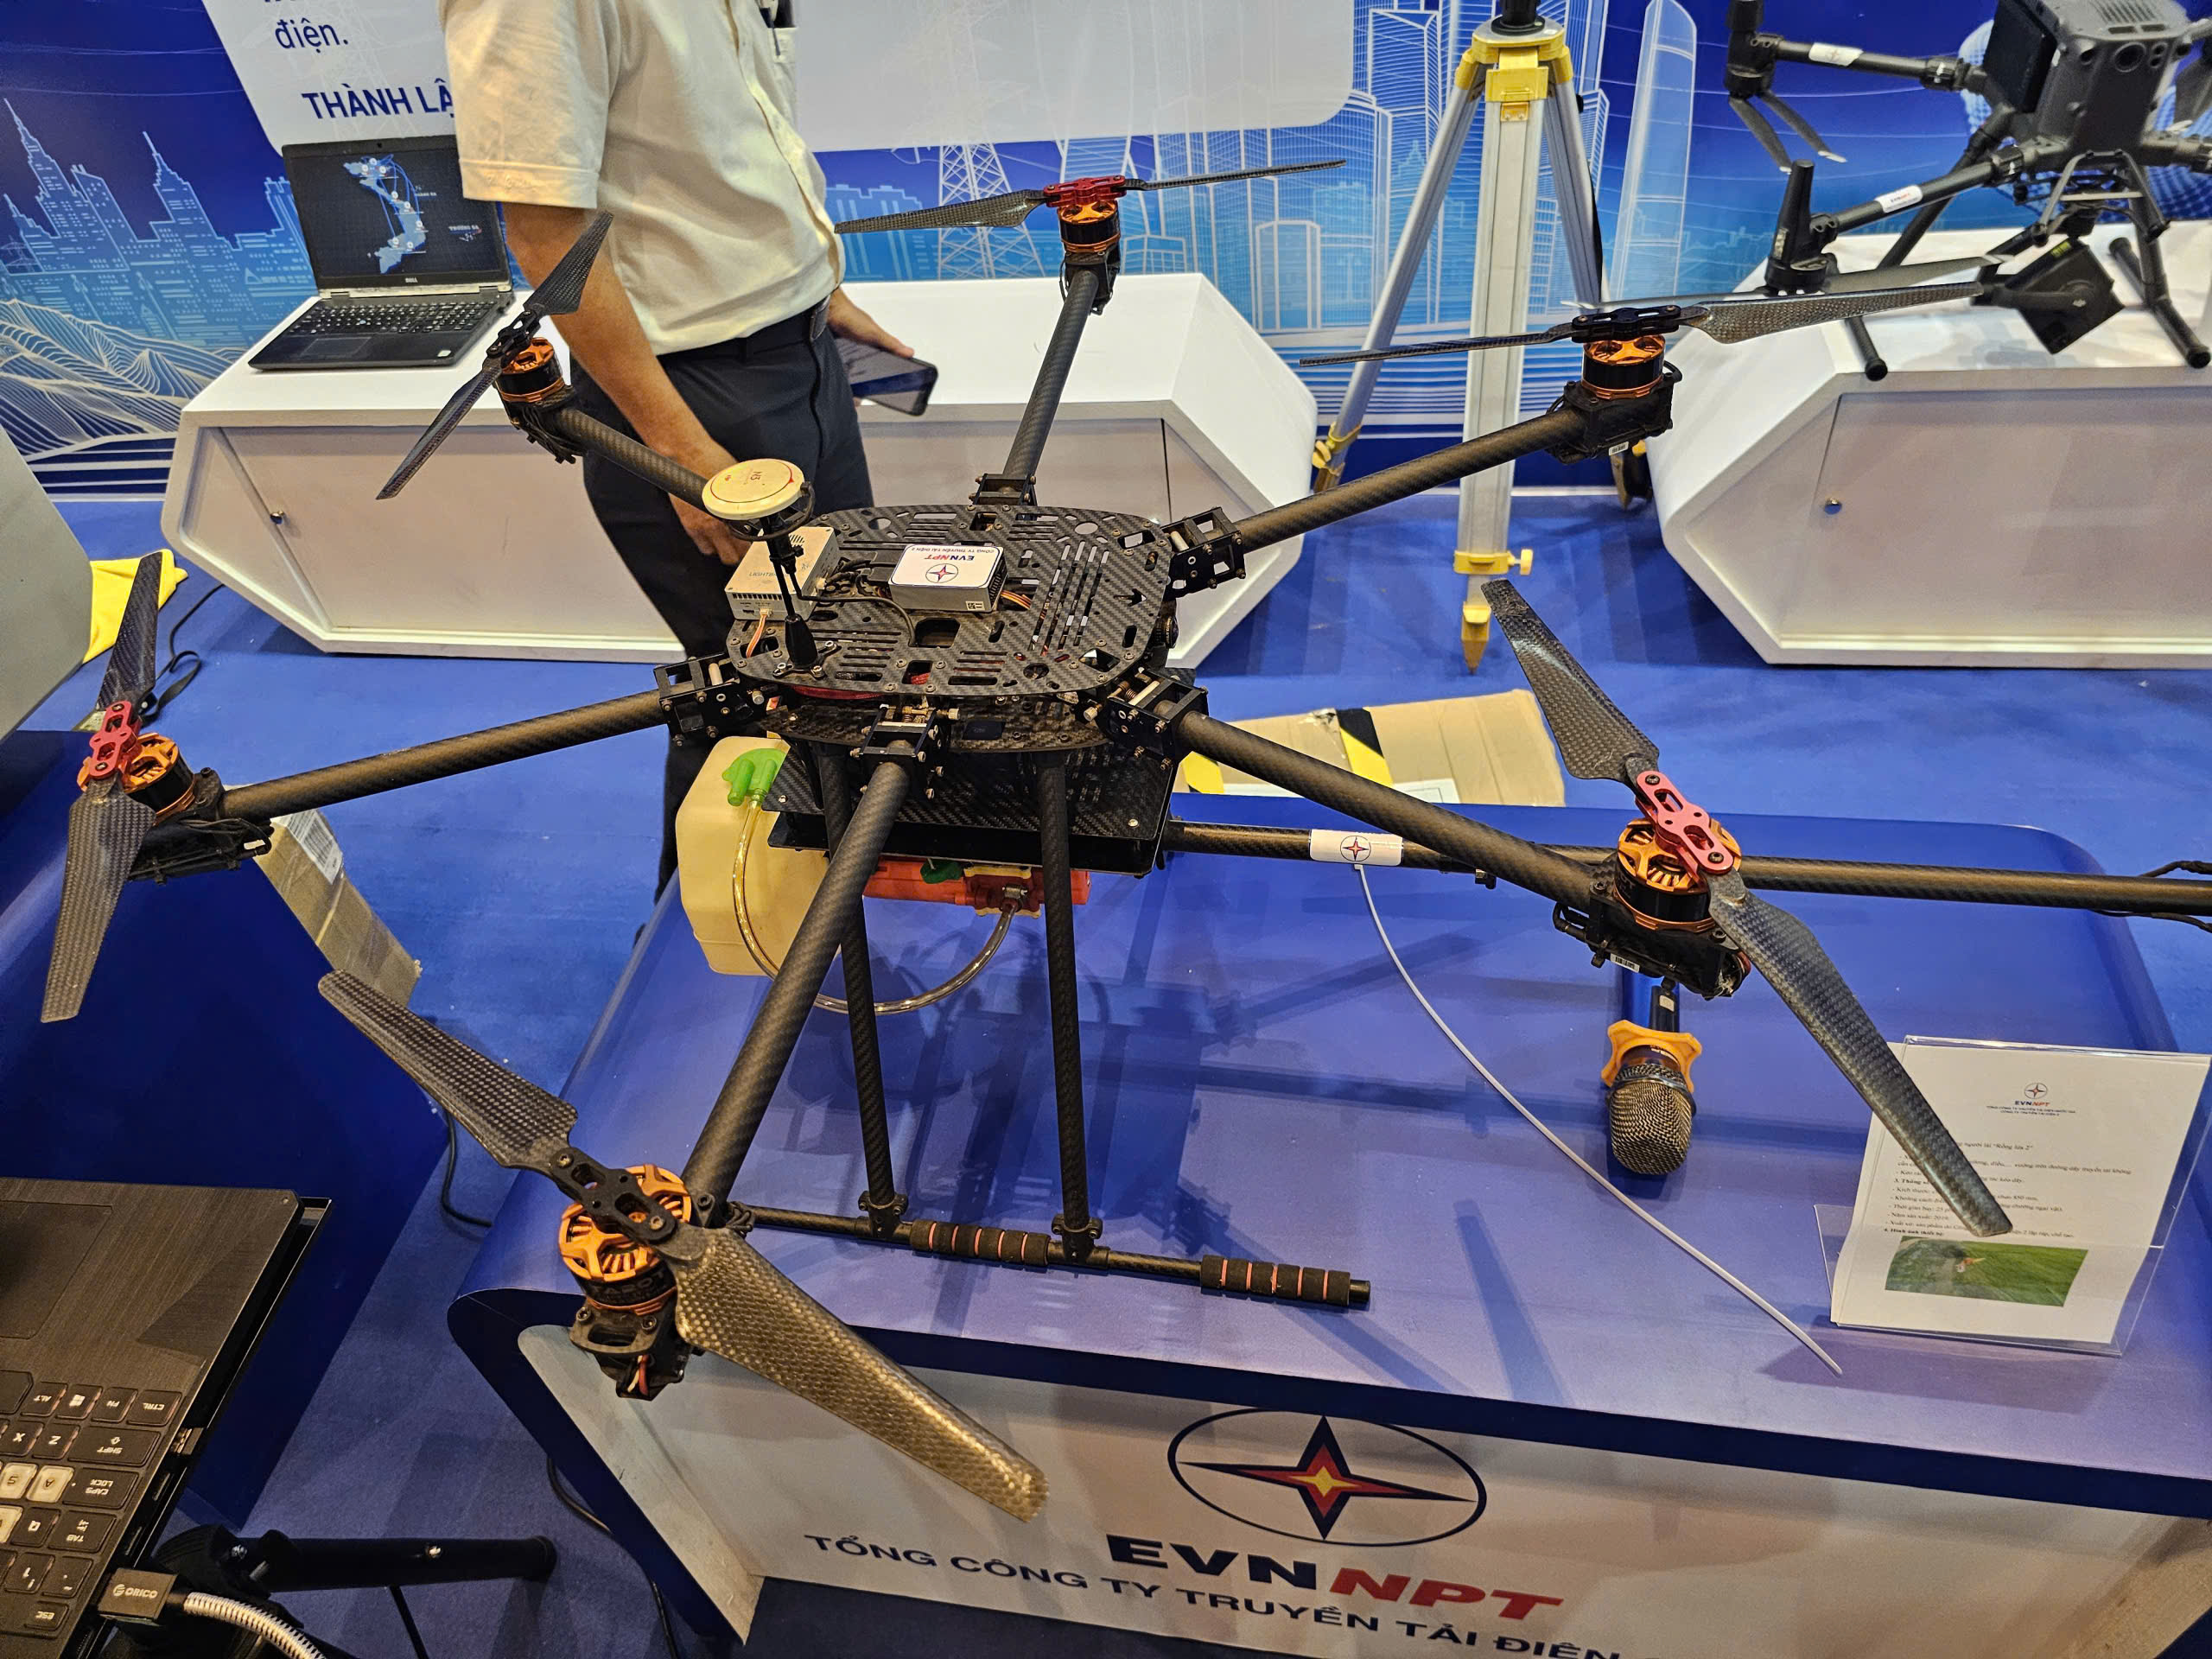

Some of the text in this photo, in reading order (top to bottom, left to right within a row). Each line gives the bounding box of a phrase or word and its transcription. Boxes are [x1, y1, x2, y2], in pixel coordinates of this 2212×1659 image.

[275, 17, 349, 54] điện.
[301, 78, 454, 119] THÀNH LẬ
[34, 1395, 53, 1403] ALT
[106, 1400, 120, 1408] FN
[143, 1402, 166, 1411] CTRL
[13, 1432, 26, 1443] X
[48, 1435, 61, 1446] Z
[96, 1446, 124, 1455] SHIFT
[7, 1475, 19, 1486] S
[45, 1478, 56, 1488] A
[89, 1478, 114, 1487] LOCK
[85, 1486, 110, 1496] CAPS
[28, 1519, 41, 1532] Q
[66, 1534, 85, 1542] TAB
[1106, 1534, 1564, 1620] EVNNPT
[124, 1587, 158, 1599] ORICO
[804, 1535, 938, 1567] TỔNG
[950, 1558, 1088, 1589] CÔNG
[1100, 1577, 1161, 1598] TY
[1176, 1588, 1379, 1631] TRUYỀN
[1395, 1620, 1478, 1646] TẢI
[35, 1611, 55, 1620] ESC
